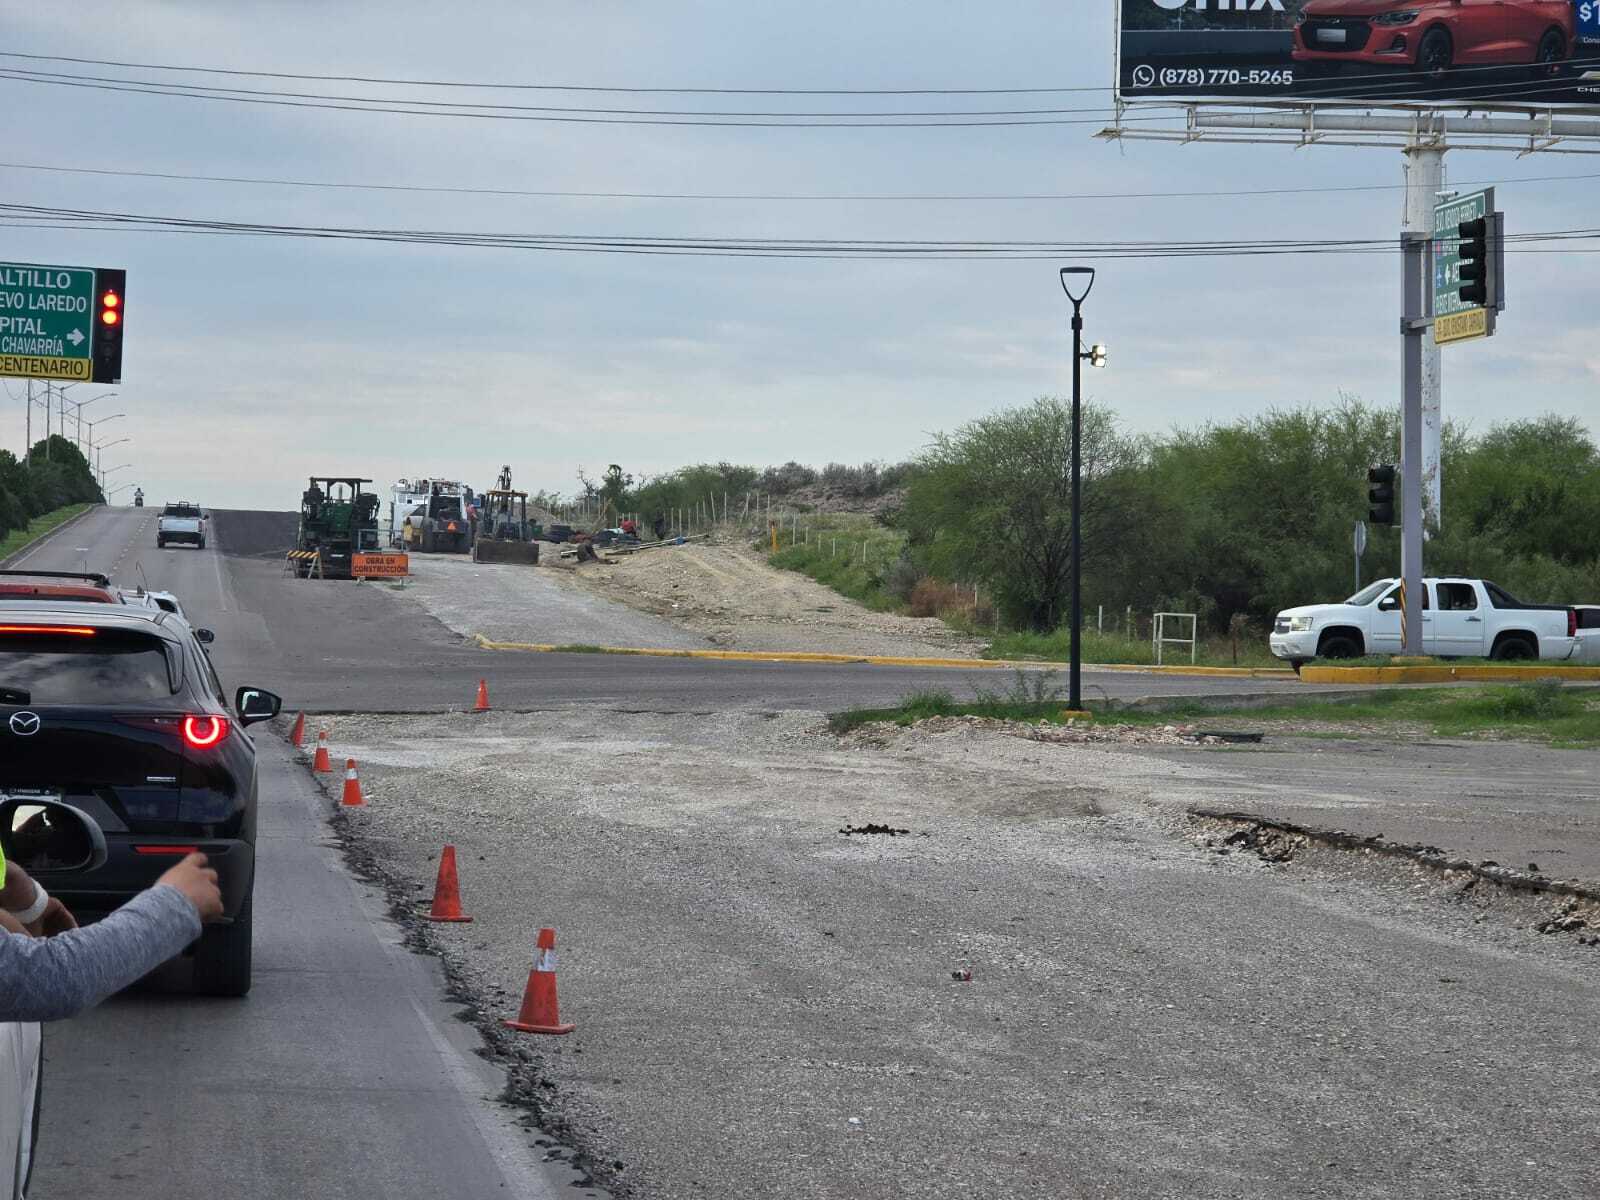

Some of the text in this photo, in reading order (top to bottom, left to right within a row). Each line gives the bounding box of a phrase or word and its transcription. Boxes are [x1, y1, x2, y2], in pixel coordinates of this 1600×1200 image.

[1160, 67, 1293, 87] (878) 770-5265
[29, 293, 87, 313] LAREDO
[0, 316, 47, 335] PITAL
[2, 335, 64, 356] CHAVARRÍA
[365, 557, 384, 565] OBRA
